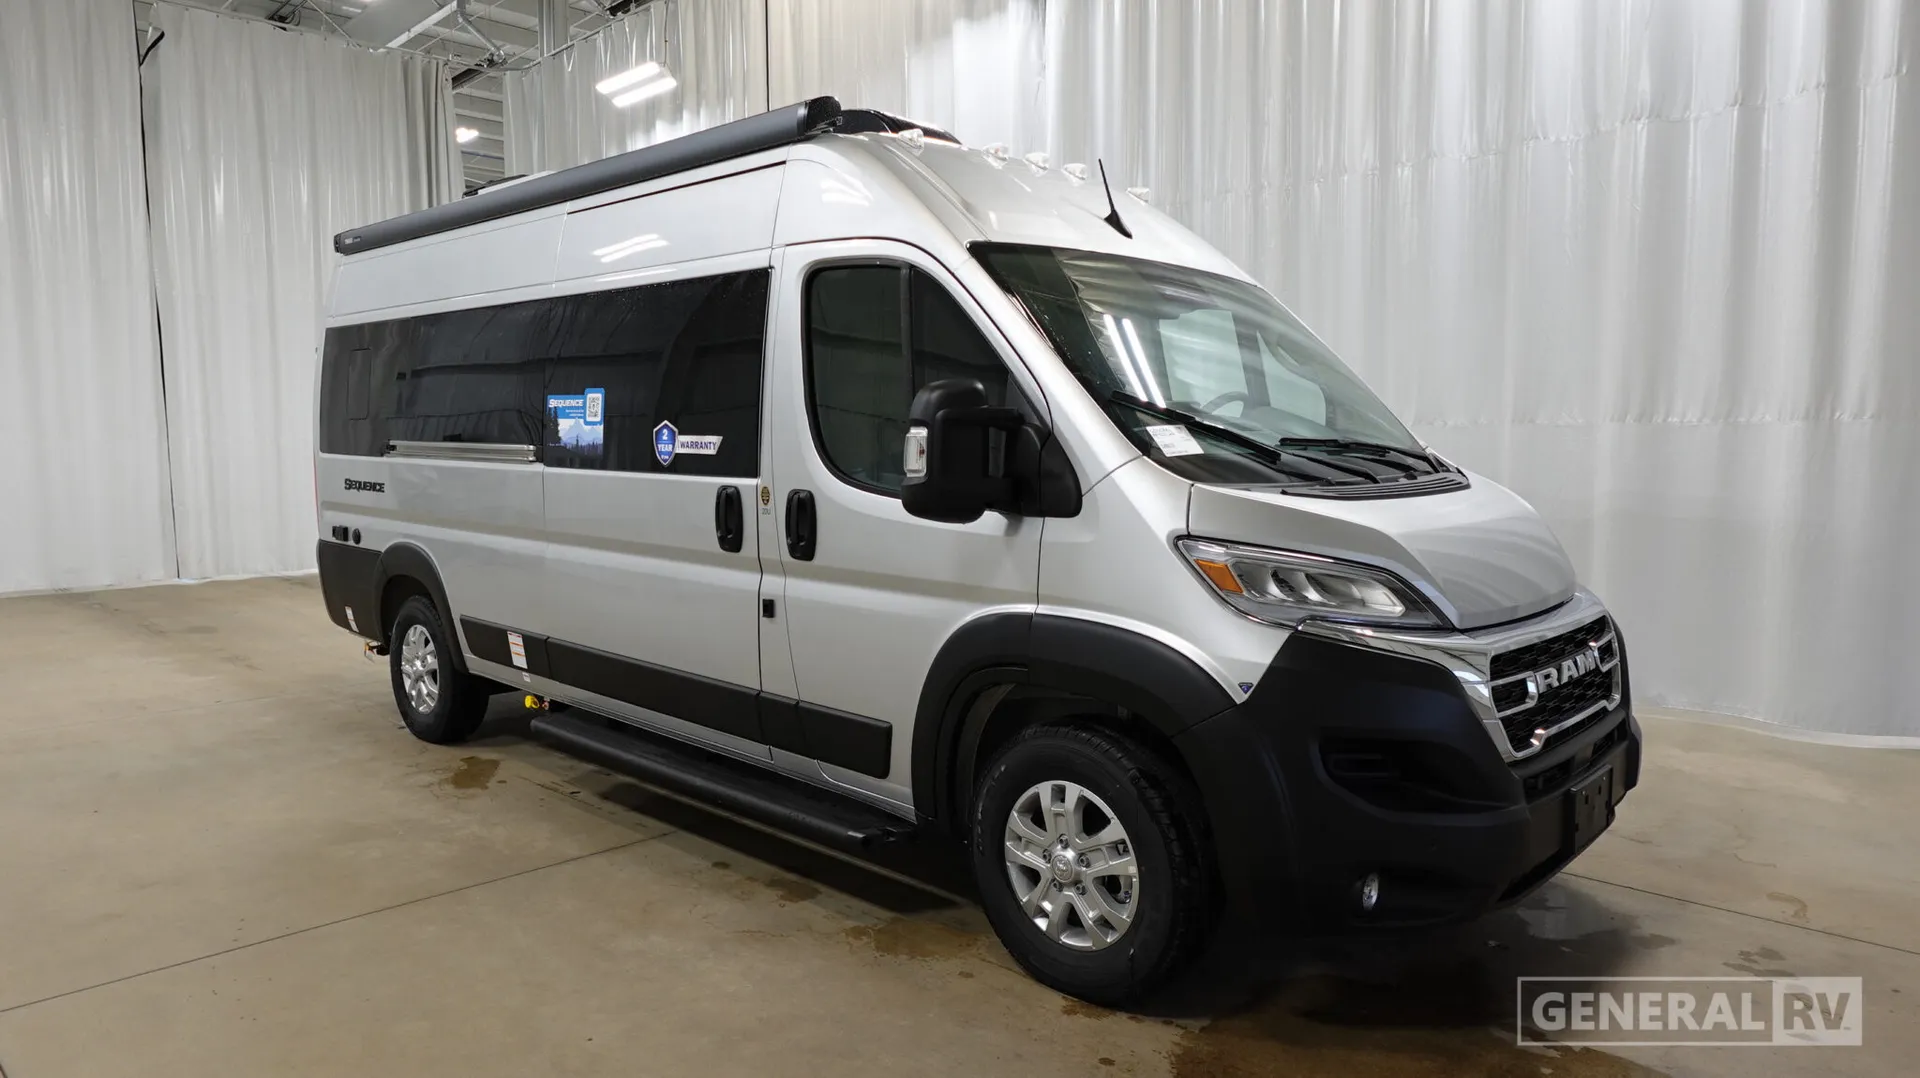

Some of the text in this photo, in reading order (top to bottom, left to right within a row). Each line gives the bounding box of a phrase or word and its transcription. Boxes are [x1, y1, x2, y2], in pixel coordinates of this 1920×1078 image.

[549, 399, 584, 408] SEQUENCE
[662, 429, 668, 441] 2
[657, 443, 673, 452] YEAR
[680, 440, 717, 451] WARRANTY
[344, 478, 385, 493] SEQUENCE
[1534, 650, 1597, 694] RAM
